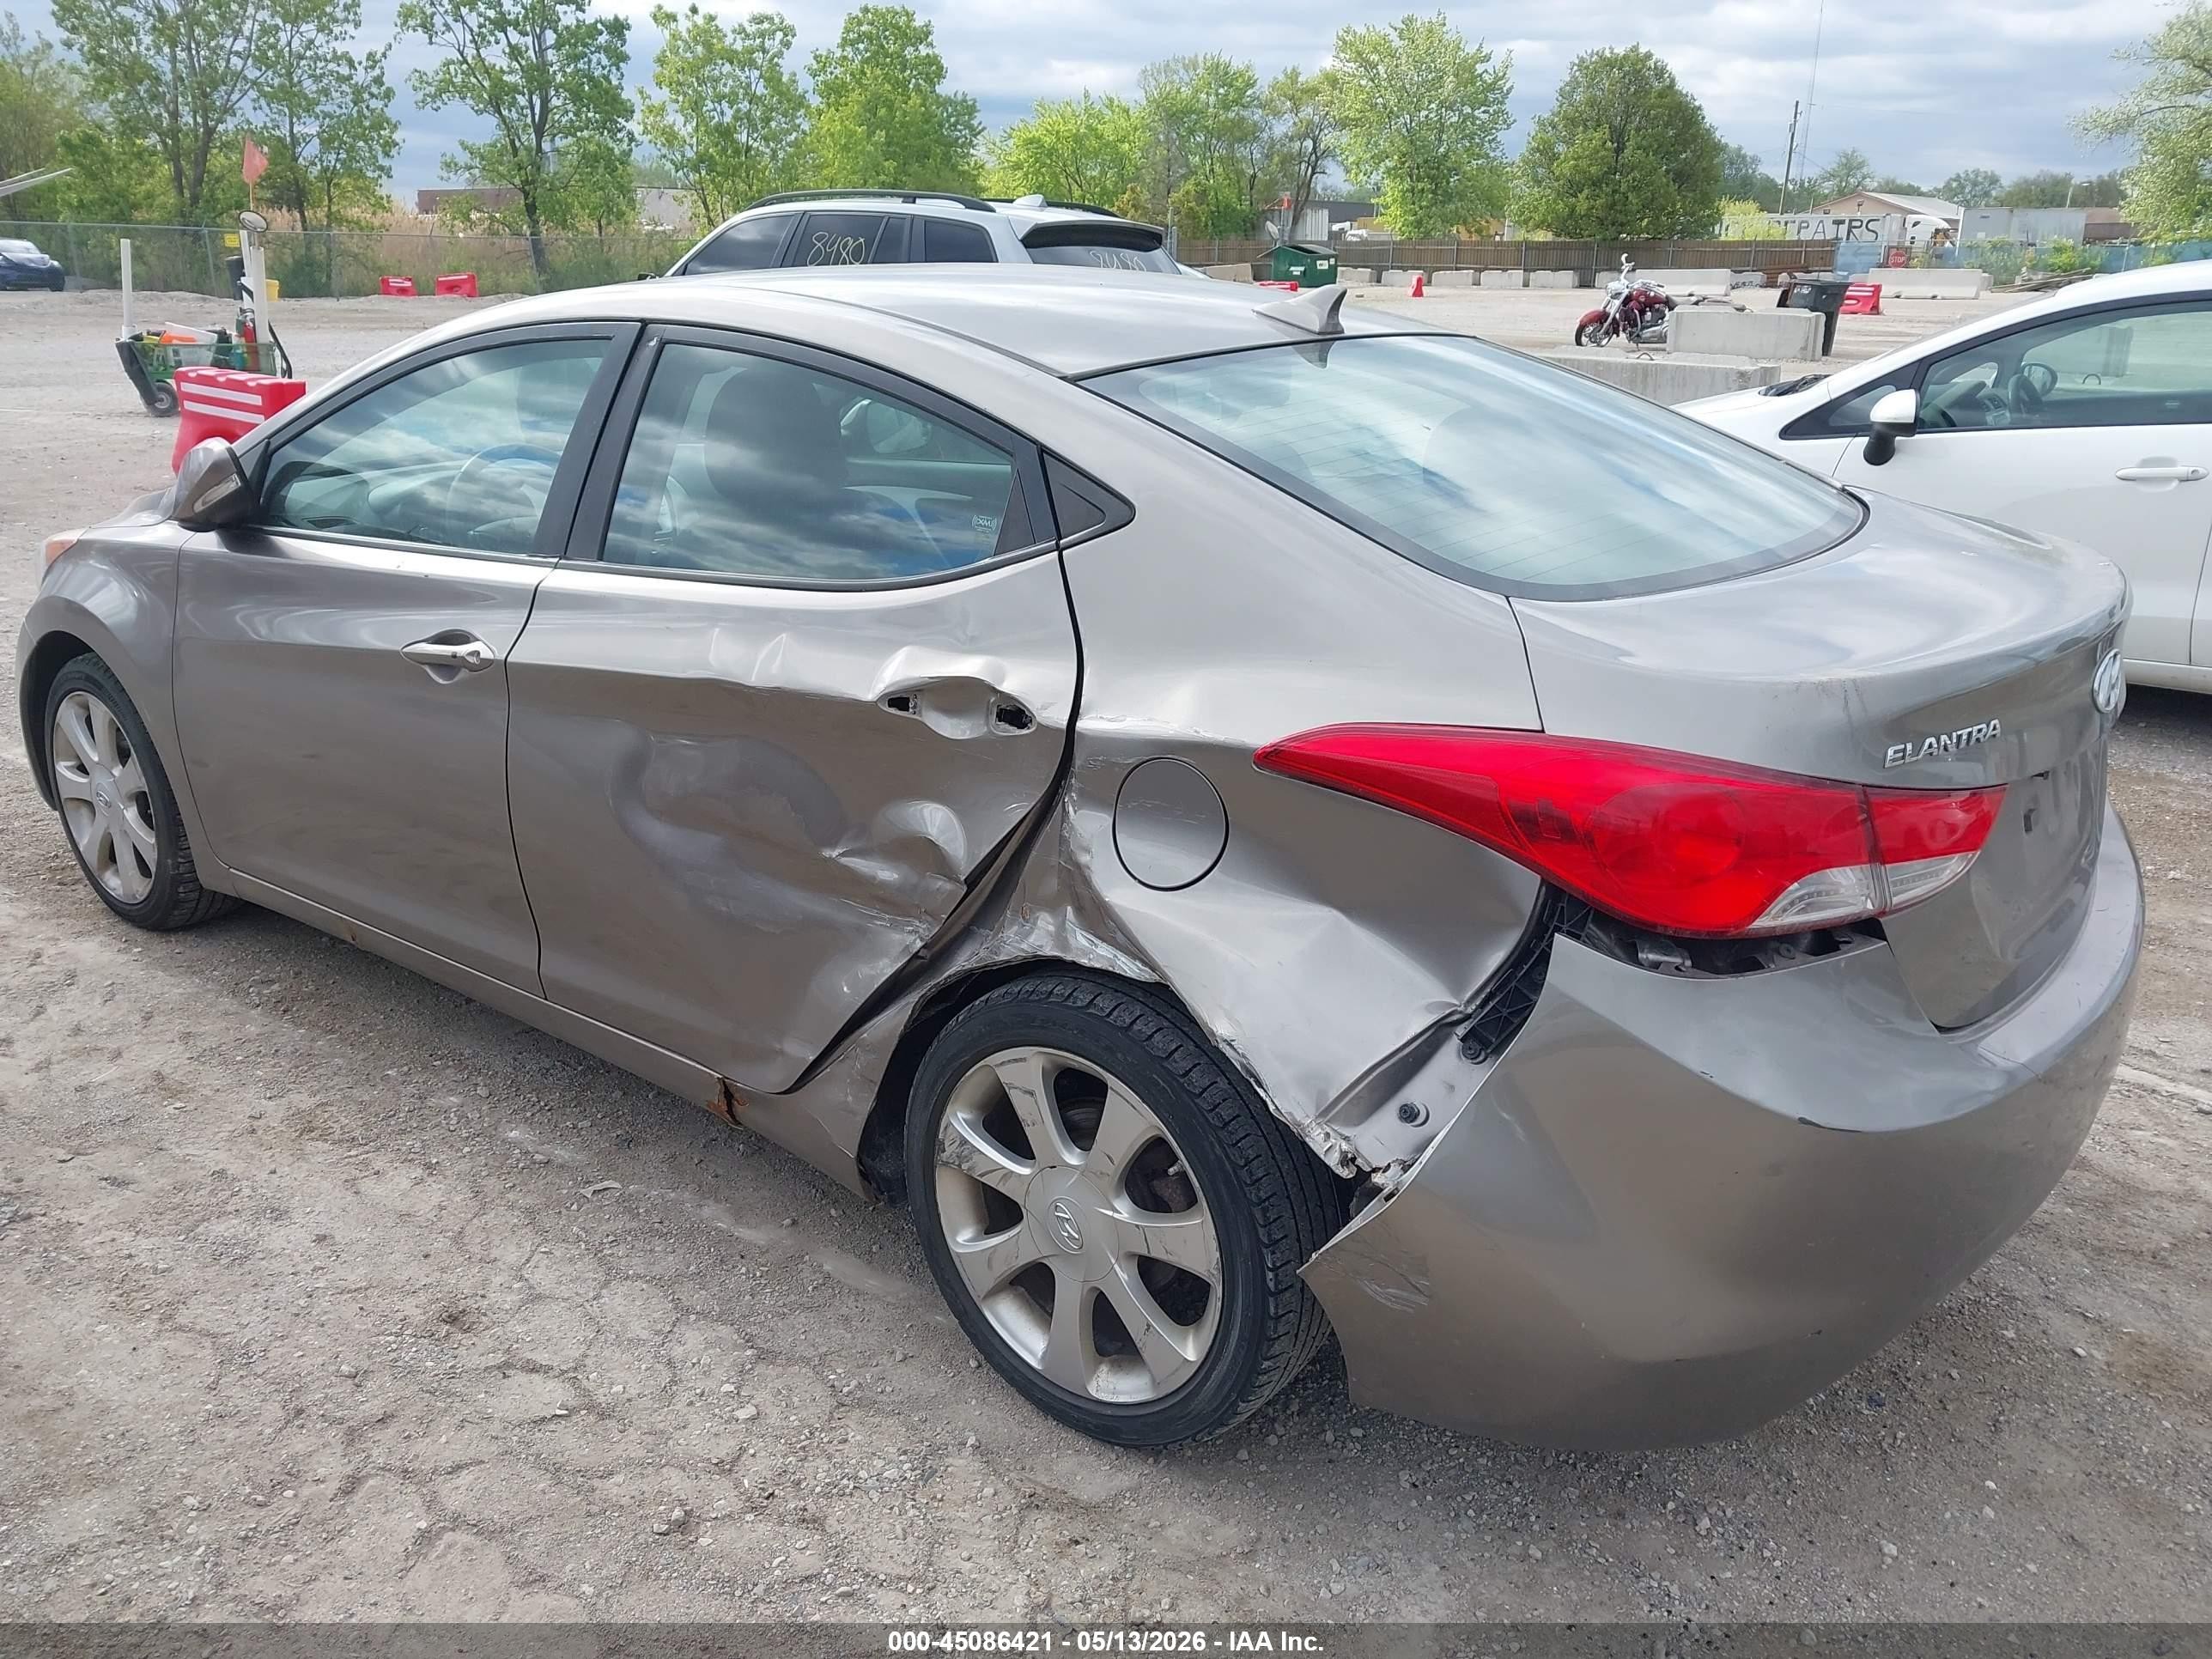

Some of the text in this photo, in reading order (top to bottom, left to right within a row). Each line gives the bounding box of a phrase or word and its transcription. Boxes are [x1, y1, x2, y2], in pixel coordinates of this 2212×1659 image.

[807, 231, 866, 267] 8480
[1891, 255, 1905, 264] STOP
[1884, 718, 2002, 769] ELANTRA
